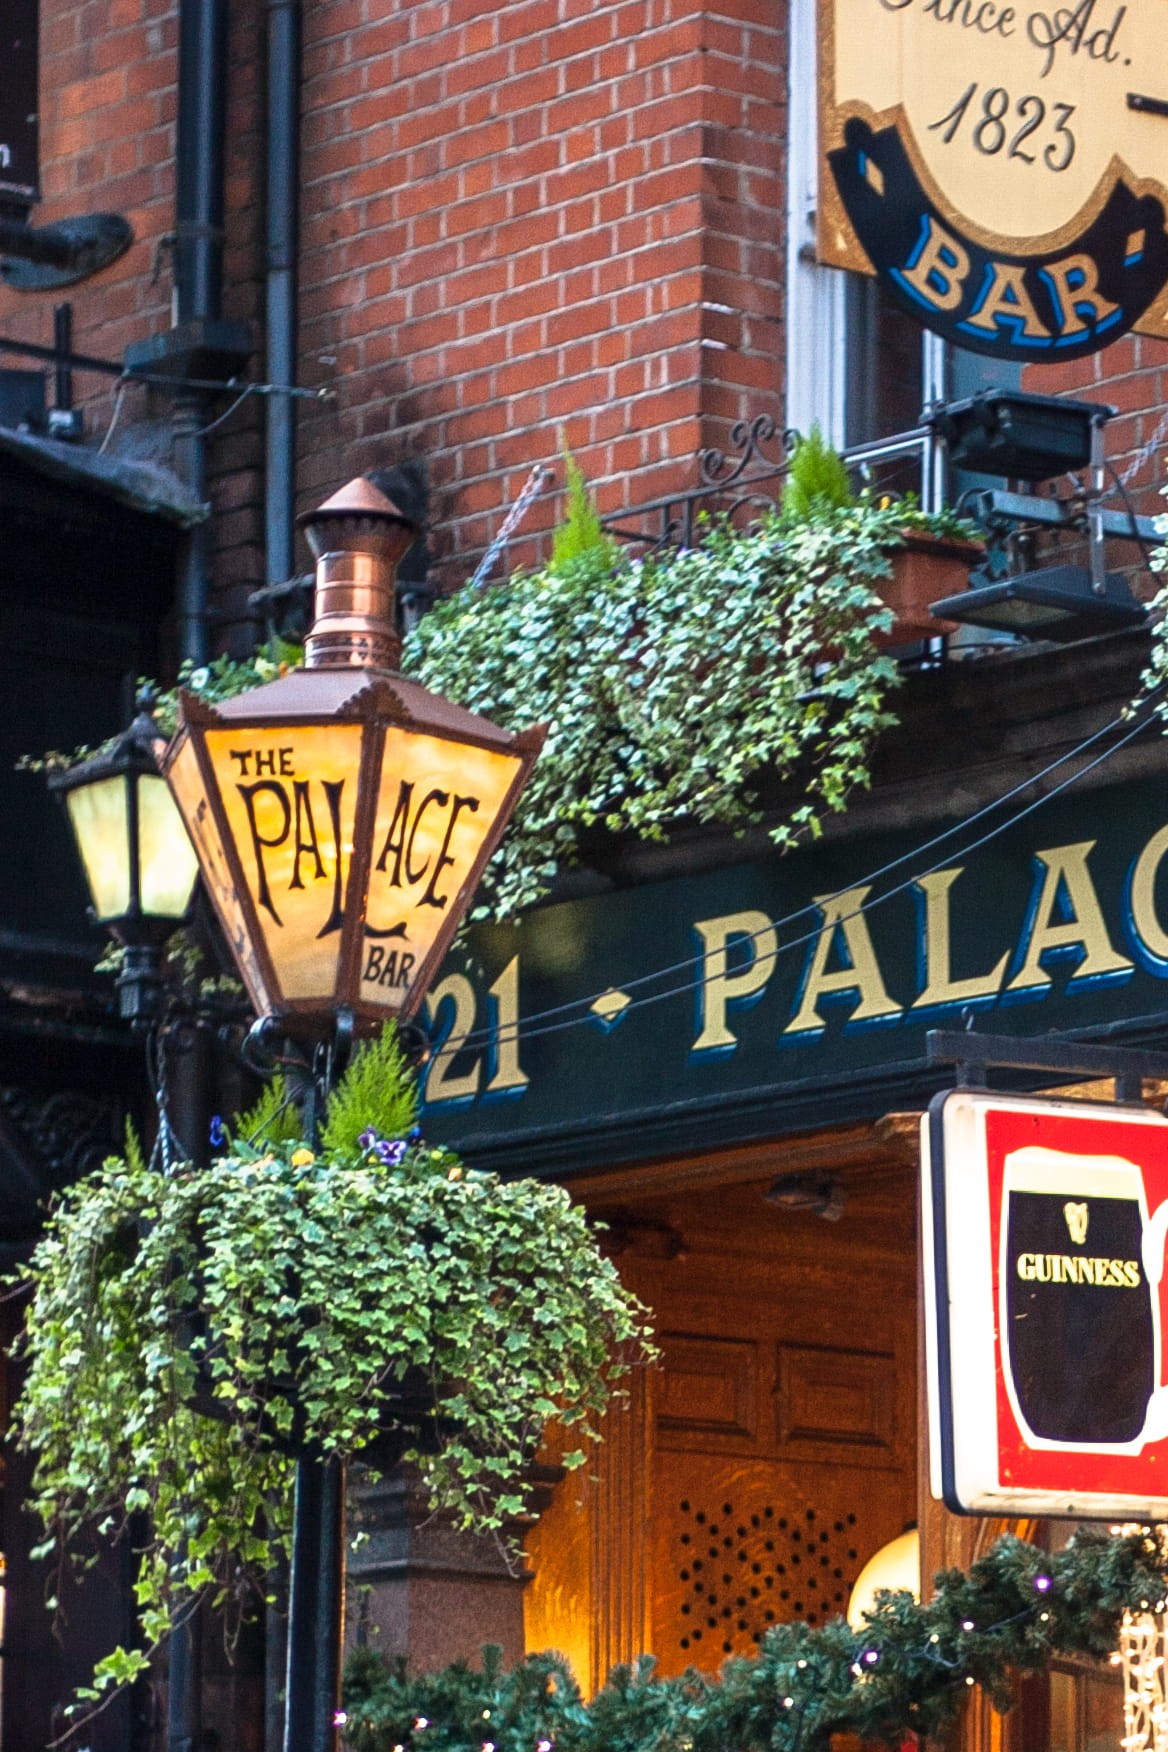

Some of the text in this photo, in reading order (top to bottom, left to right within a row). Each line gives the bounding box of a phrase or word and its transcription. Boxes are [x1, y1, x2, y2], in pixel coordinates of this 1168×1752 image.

[878, 0, 1015, 38] ince
[928, 82, 1077, 172] 1823
[892, 215, 1122, 347] BAR
[229, 747, 295, 777] THE
[236, 778, 481, 940] PALACE
[364, 945, 416, 990] BAR
[421, 953, 531, 1112] 21
[1017, 1252, 1140, 1288] GUINNESS
